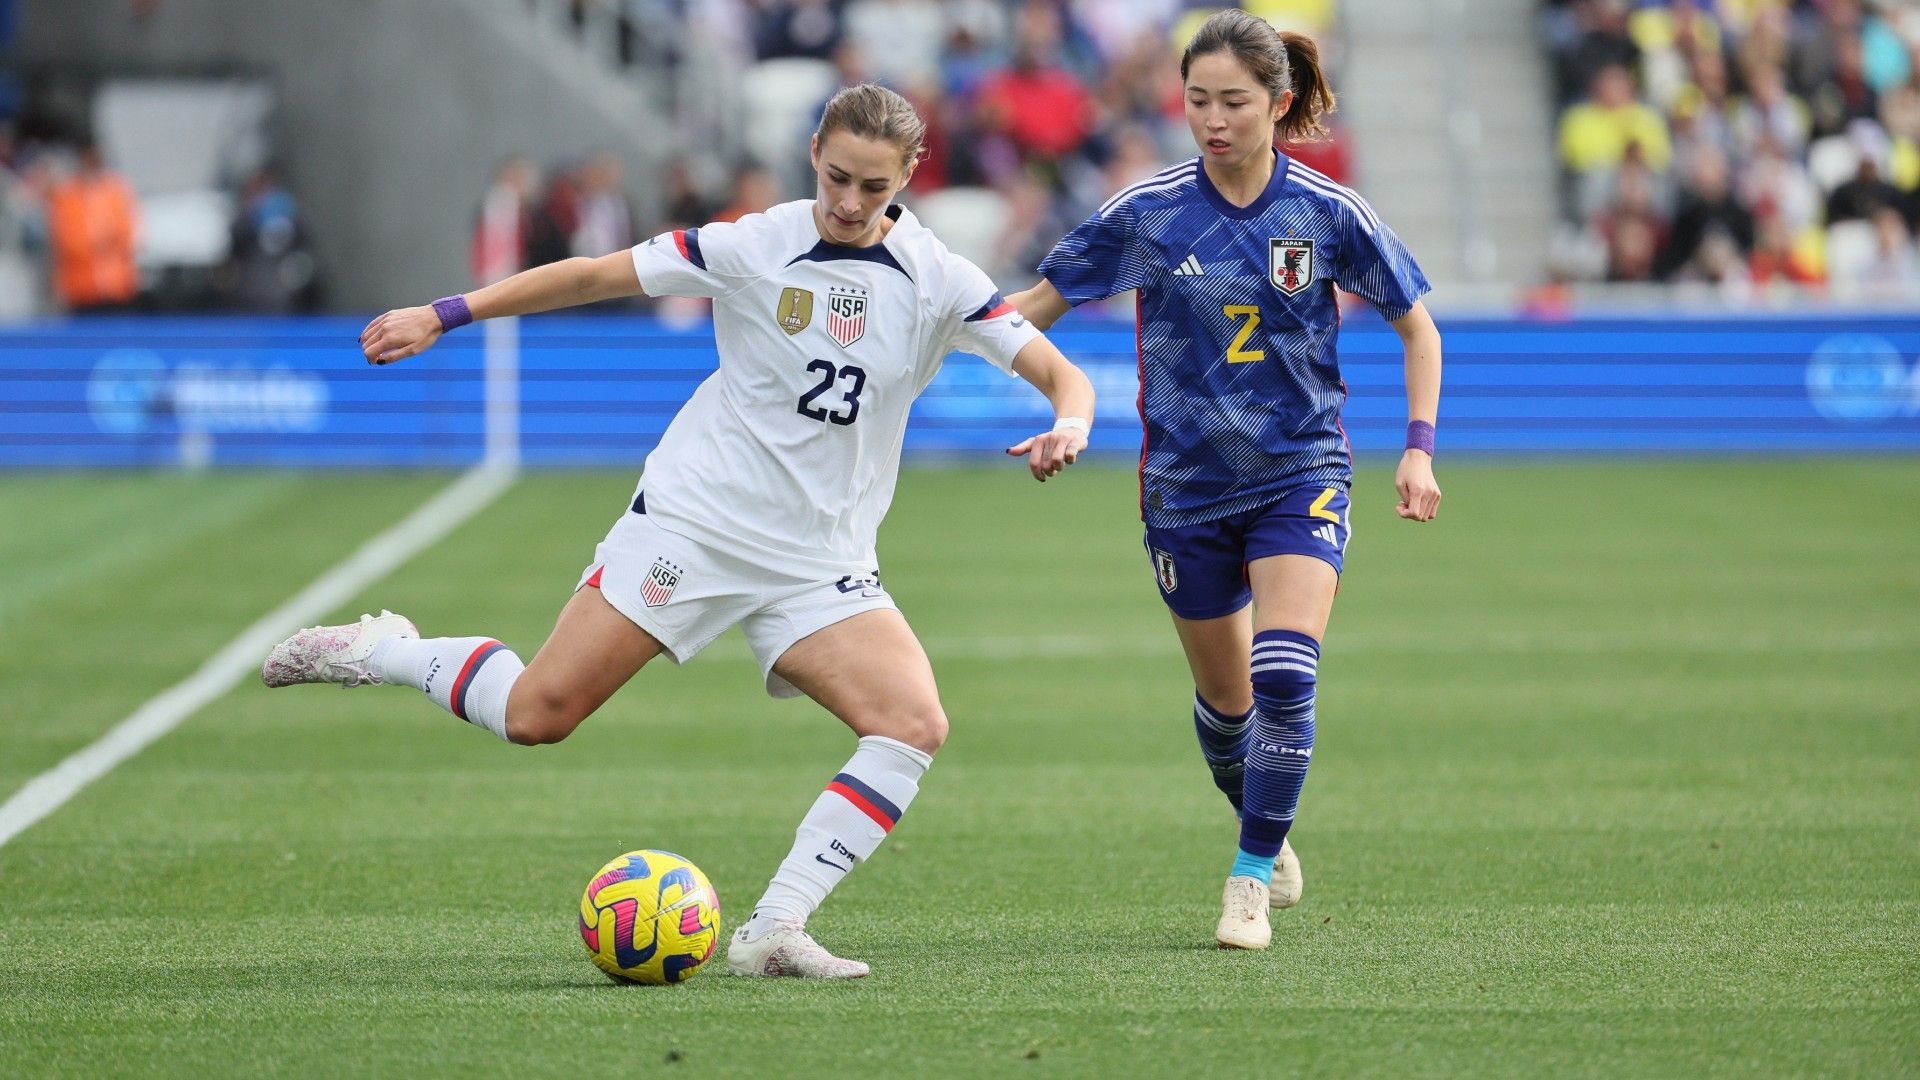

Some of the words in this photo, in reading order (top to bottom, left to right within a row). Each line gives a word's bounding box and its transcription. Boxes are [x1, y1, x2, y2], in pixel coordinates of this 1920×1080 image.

[784, 316, 801, 325] FIFA
[831, 297, 864, 318] USA
[1223, 304, 1265, 363] 2
[797, 358, 867, 426] 23
[1309, 487, 1340, 524] 2
[651, 566, 678, 587] USA
